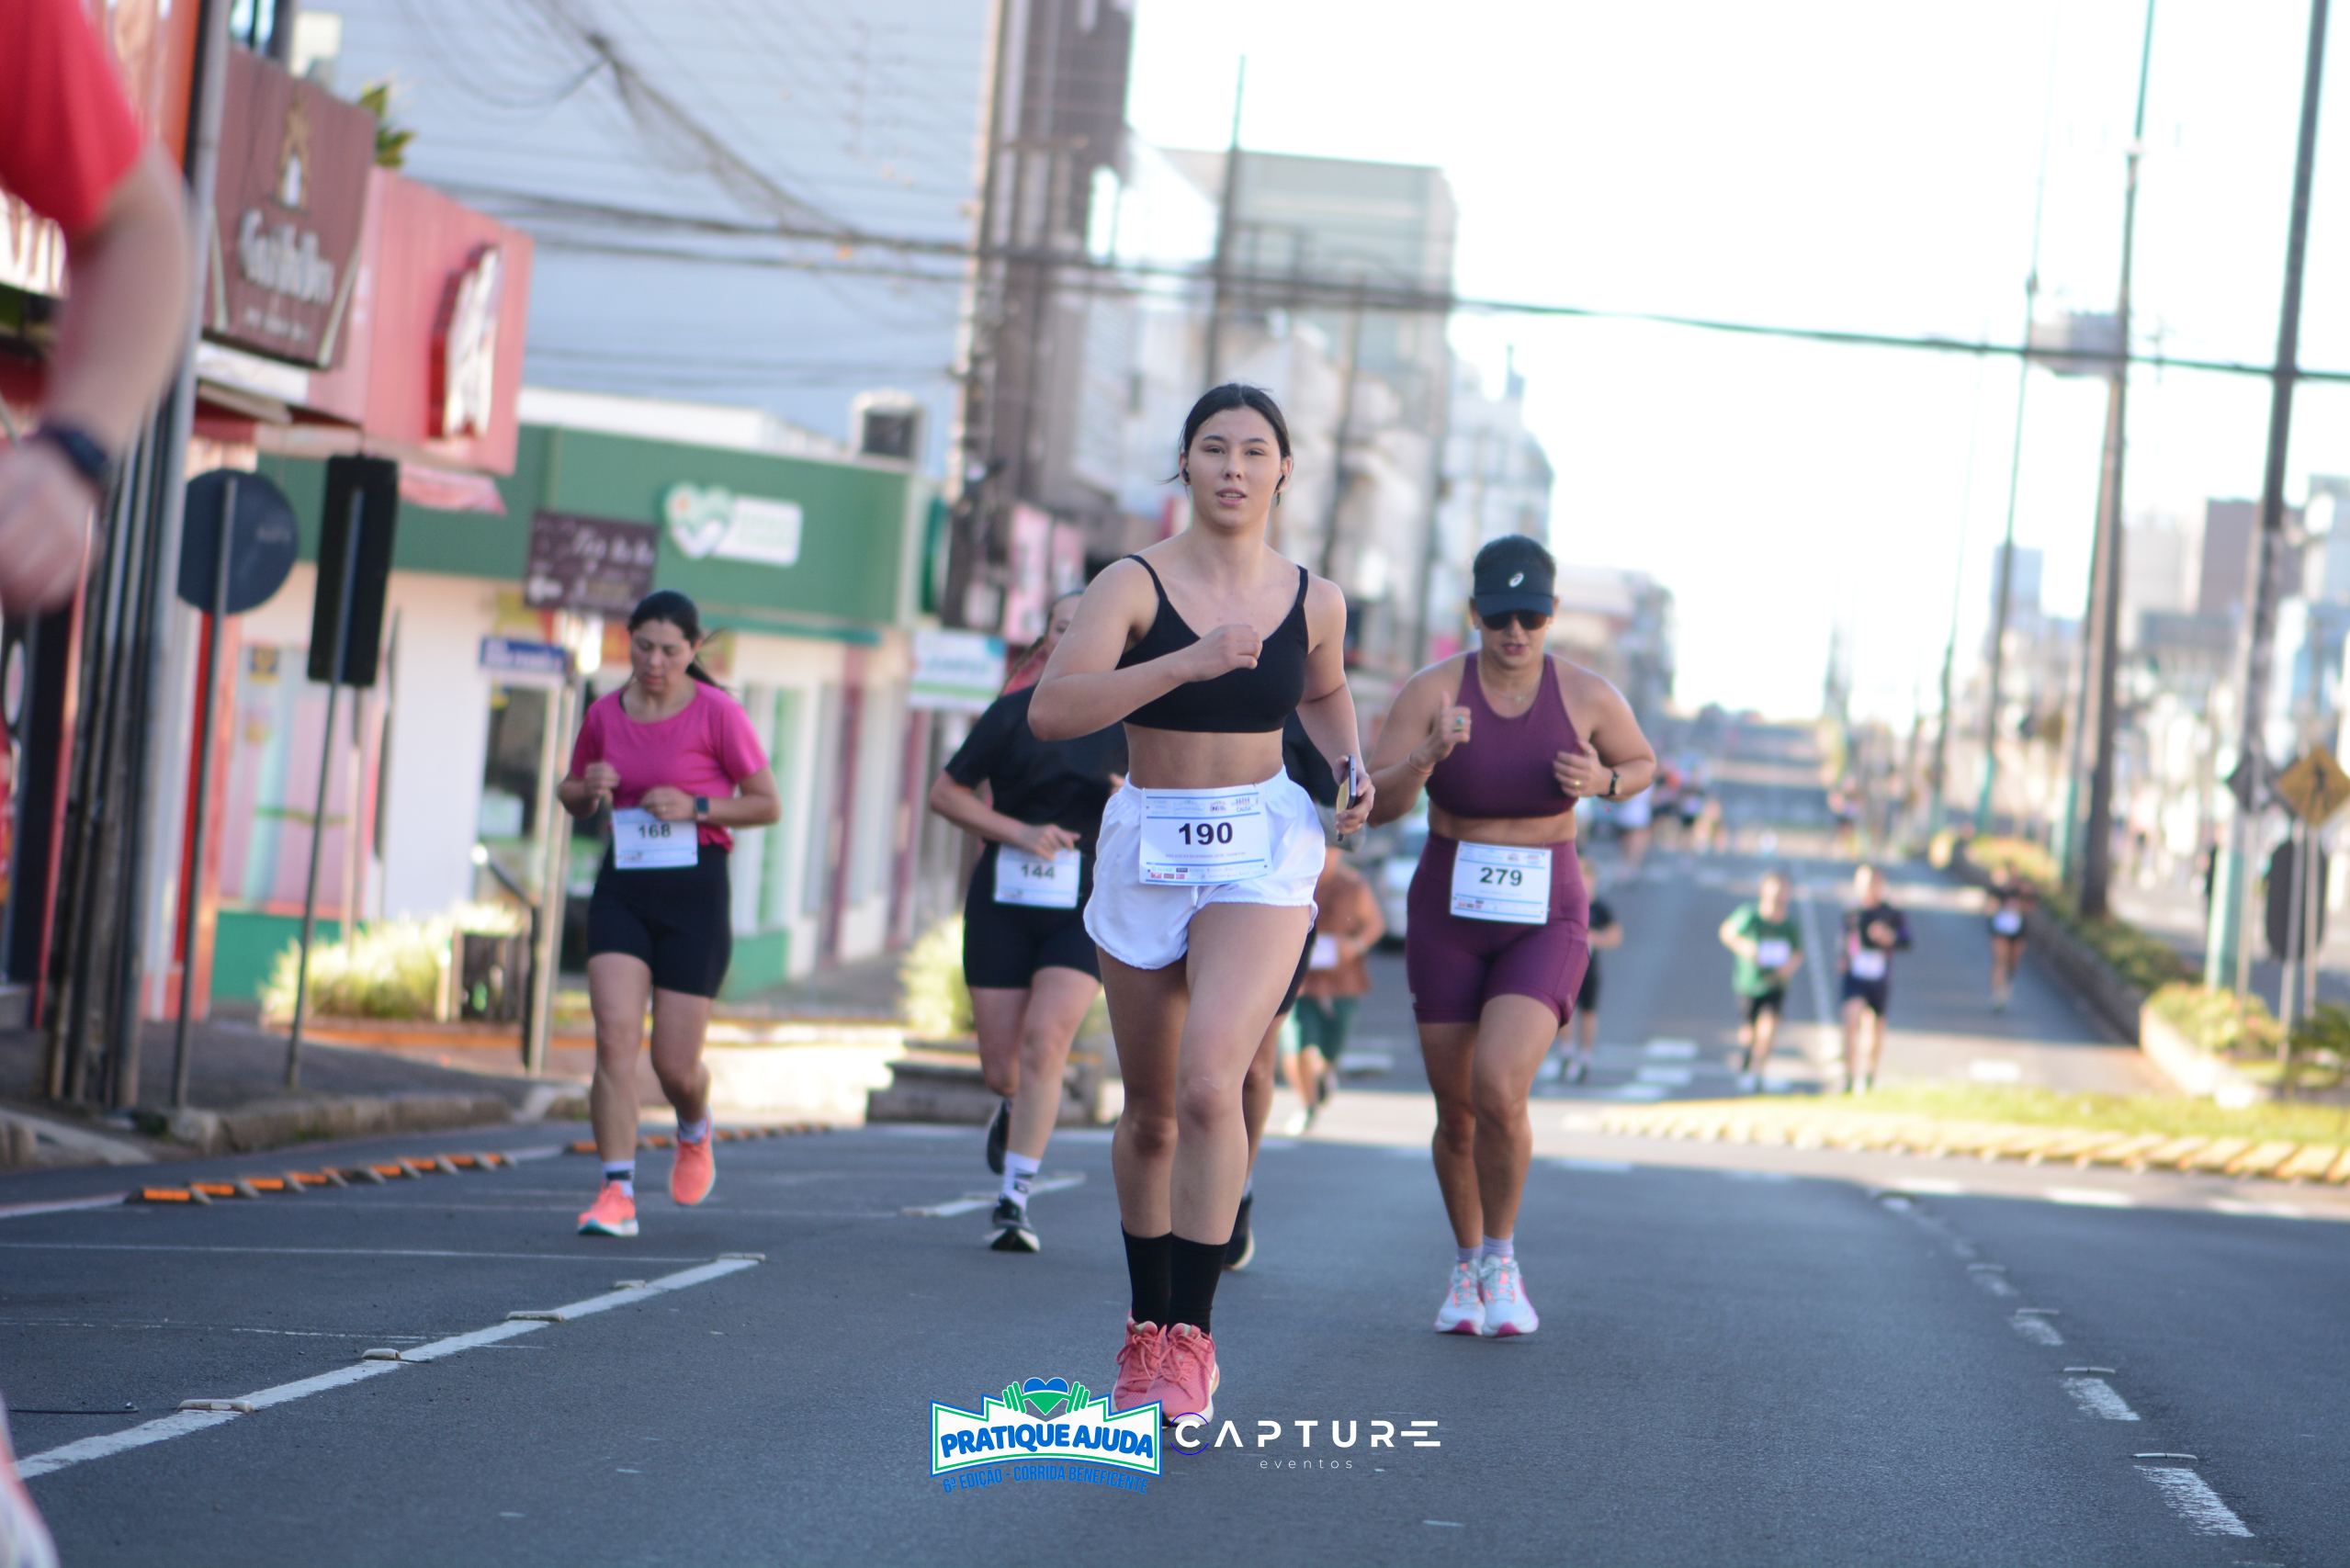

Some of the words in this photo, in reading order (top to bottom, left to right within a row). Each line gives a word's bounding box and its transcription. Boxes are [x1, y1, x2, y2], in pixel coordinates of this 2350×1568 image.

[638, 824, 672, 839] 168
[1179, 822, 1233, 845] 190
[1021, 863, 1056, 879] 144
[1479, 866, 1523, 886] 279
